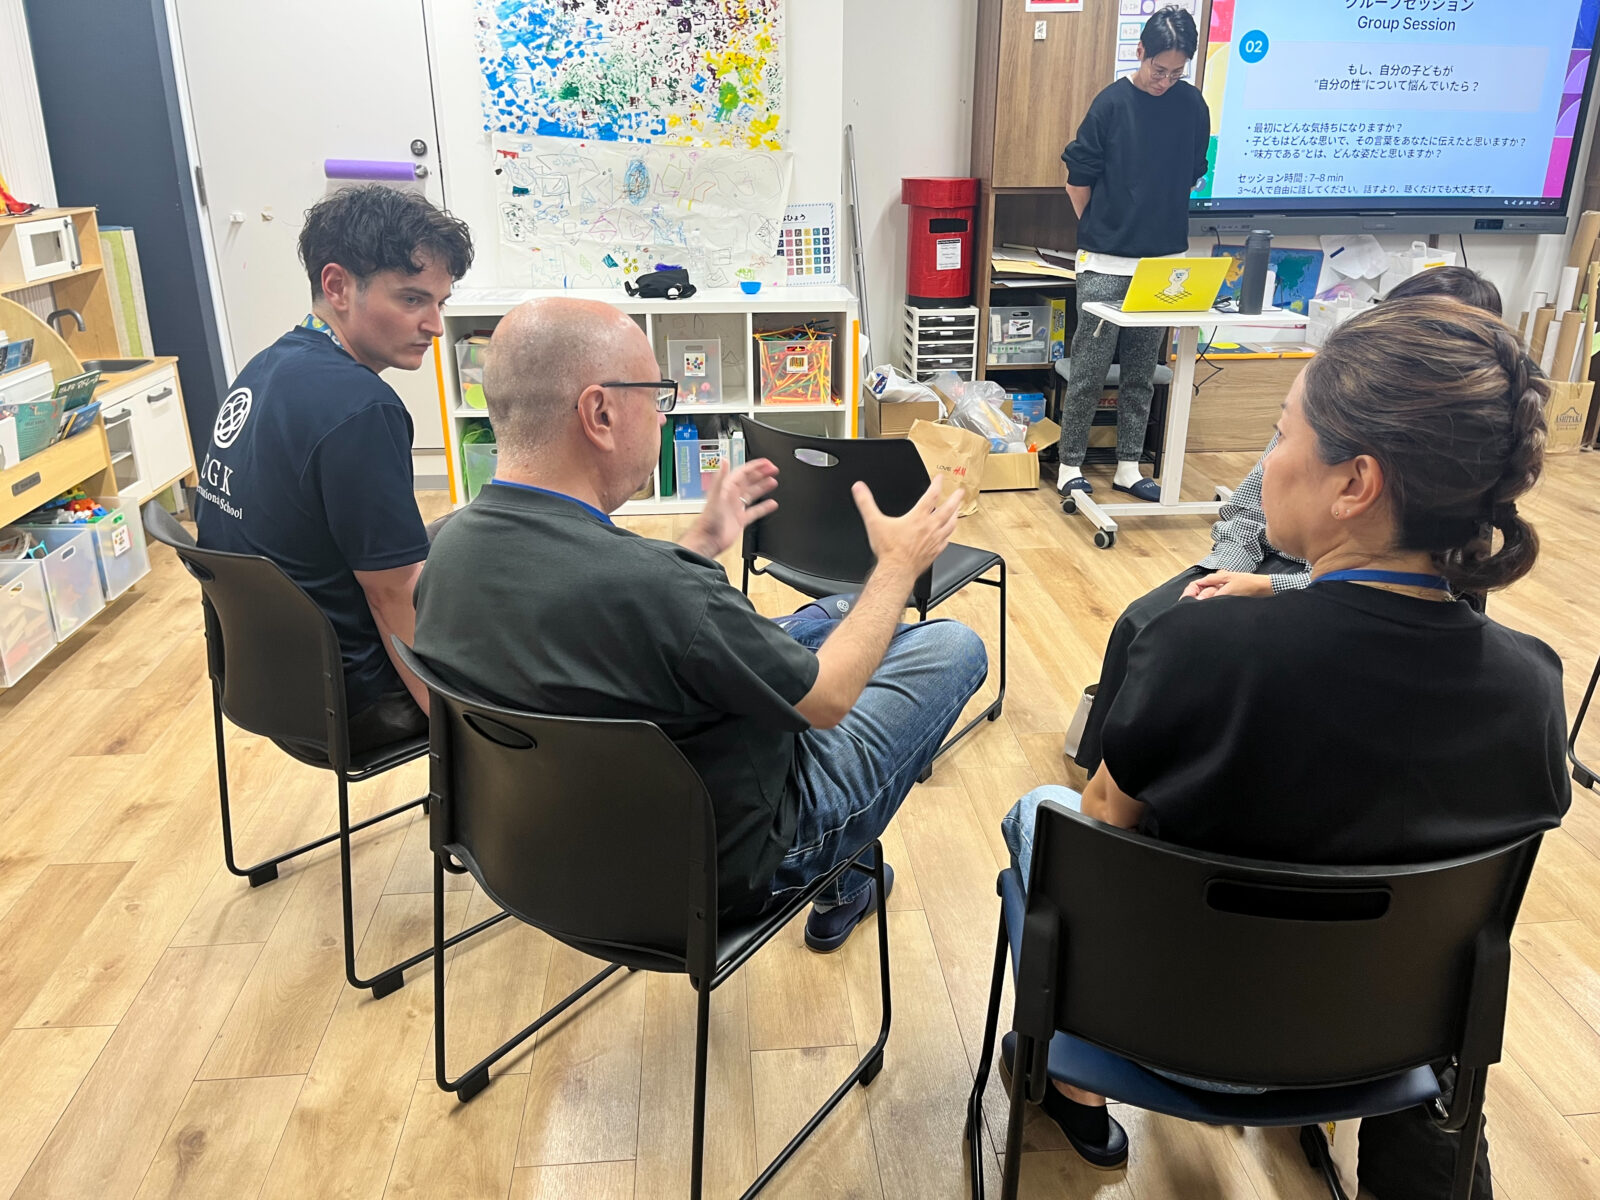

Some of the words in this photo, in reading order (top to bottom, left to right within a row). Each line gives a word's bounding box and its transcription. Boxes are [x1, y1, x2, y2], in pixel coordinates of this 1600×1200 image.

[1357, 15, 1400, 32] Group
[1402, 16, 1456, 31] Session
[1245, 40, 1263, 53] 02
[1348, 64, 1453, 76] もし、自分の子どもが
[1327, 173, 1345, 182] min
[220, 498, 243, 520] School
